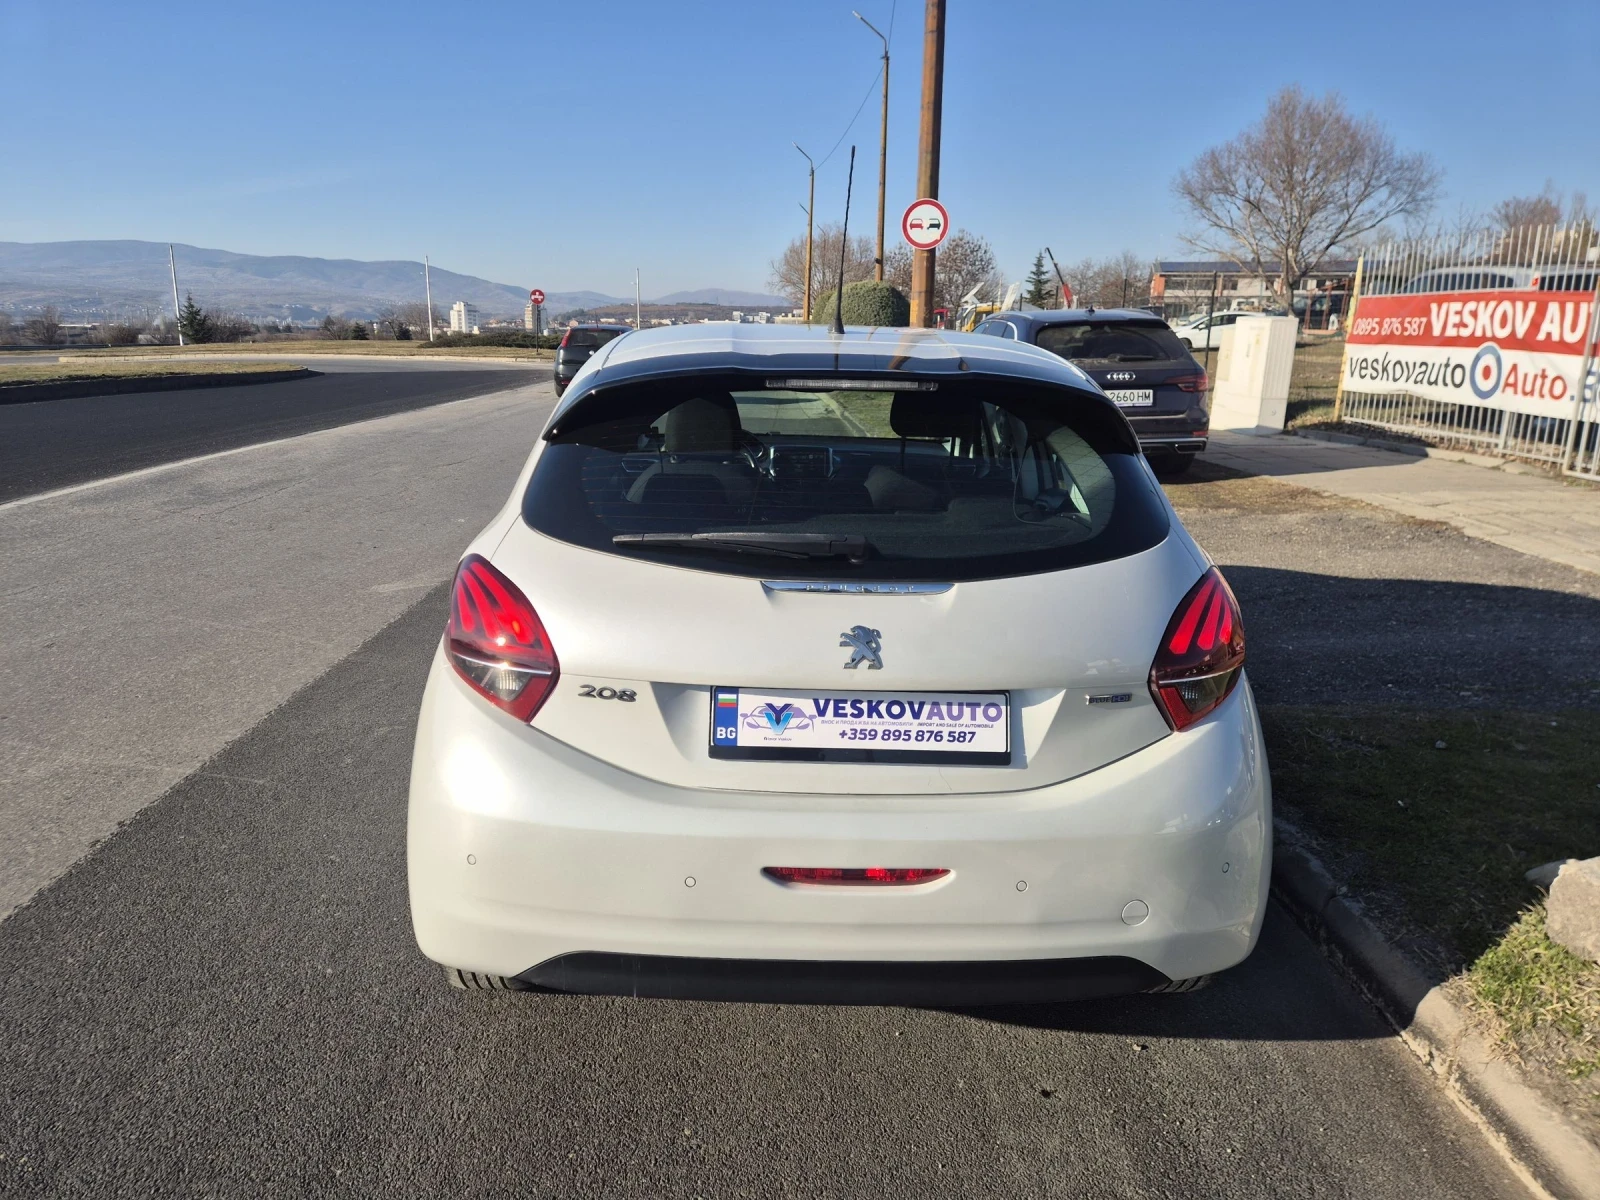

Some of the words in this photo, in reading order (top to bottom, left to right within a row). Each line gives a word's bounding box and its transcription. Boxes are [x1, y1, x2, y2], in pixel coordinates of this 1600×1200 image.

[1353, 317, 1380, 336] 0895
[1381, 317, 1402, 336] 876
[1403, 316, 1428, 336] 587
[1430, 300, 1537, 339] VESKOV
[1350, 351, 1466, 388] veskovauto
[1110, 391, 1135, 402] 2660
[1137, 391, 1151, 402] HM
[577, 684, 638, 703] 208
[812, 698, 1003, 722] VESKOVAUTO
[716, 727, 737, 739] BG
[839, 728, 878, 741] +359
[881, 729, 912, 742] 895
[914, 730, 944, 742] 876
[946, 731, 977, 743] 587
